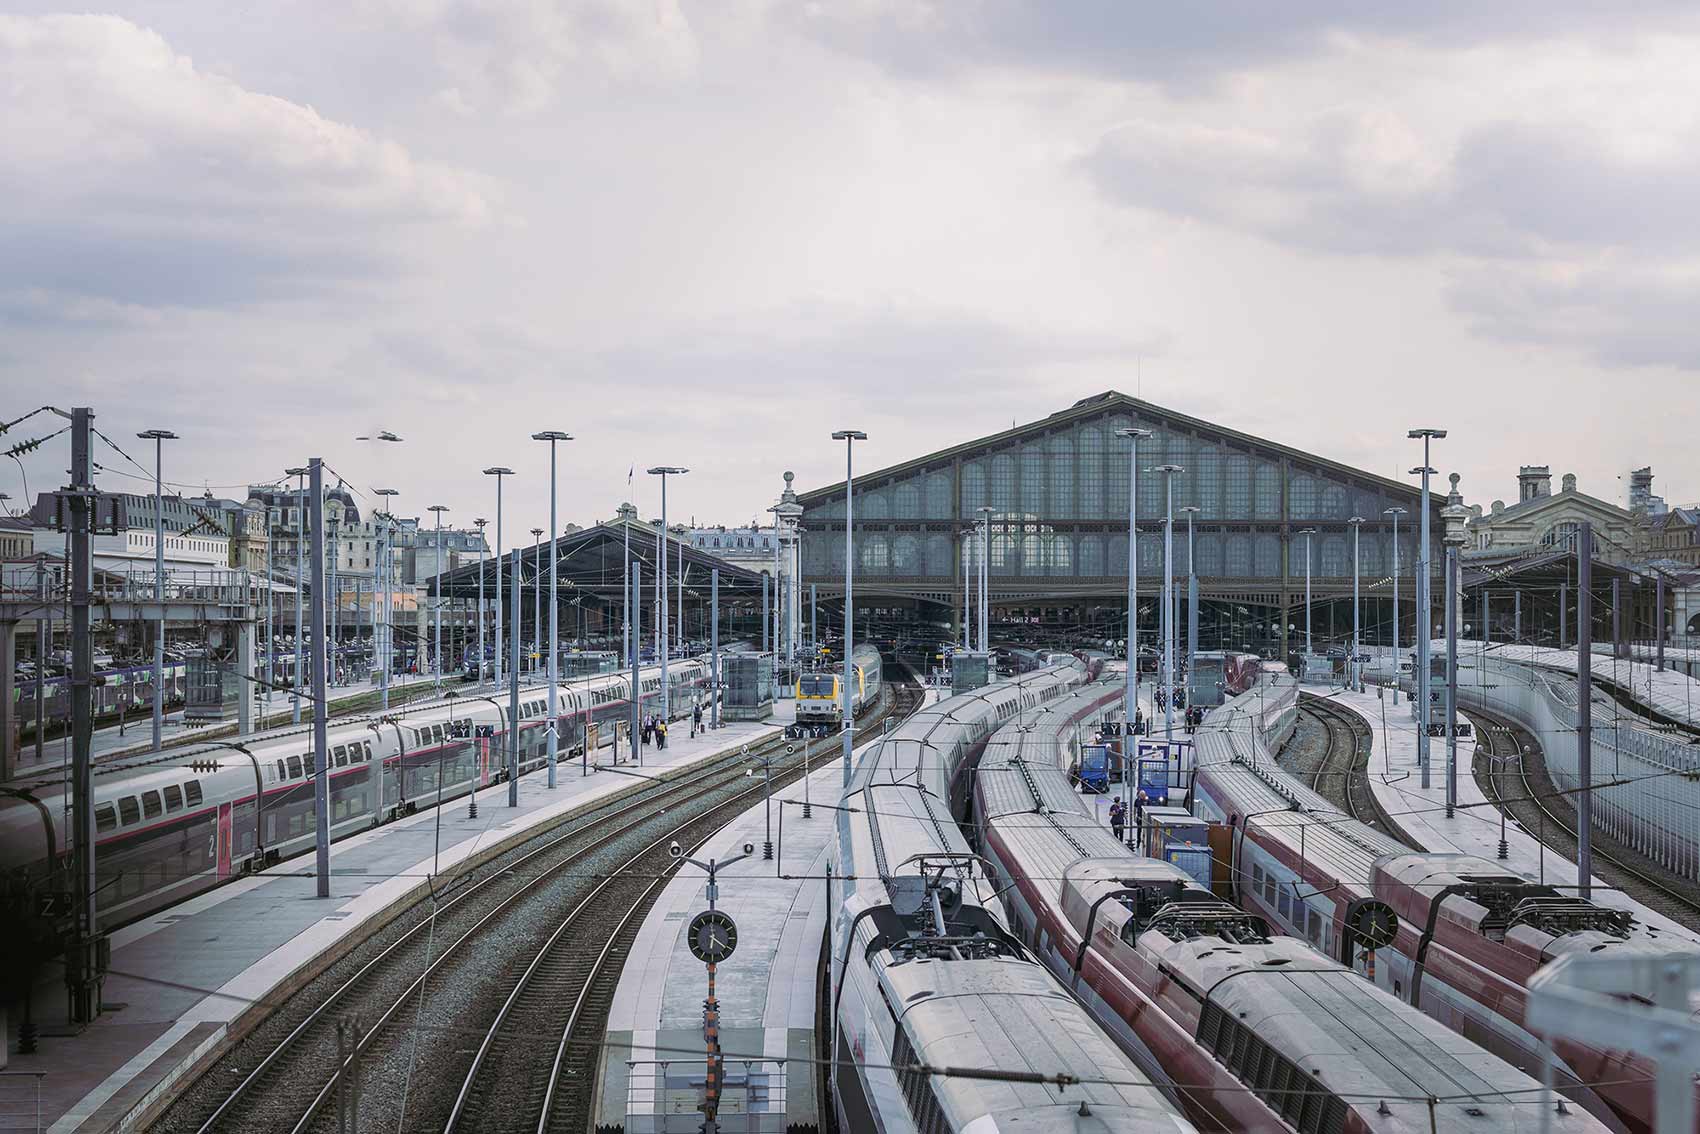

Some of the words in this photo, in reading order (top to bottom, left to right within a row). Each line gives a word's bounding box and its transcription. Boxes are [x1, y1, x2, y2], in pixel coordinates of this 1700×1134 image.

[460, 727, 467, 737] Y
[478, 727, 486, 737] Y
[794, 727, 801, 738] Y
[812, 727, 820, 738] Y
[1110, 725, 1118, 734] Y
[1129, 725, 1137, 734] Y
[1435, 726, 1443, 736] Y
[1455, 726, 1463, 736] Y
[208, 837, 215, 858] 2
[41, 898, 55, 916] Z
